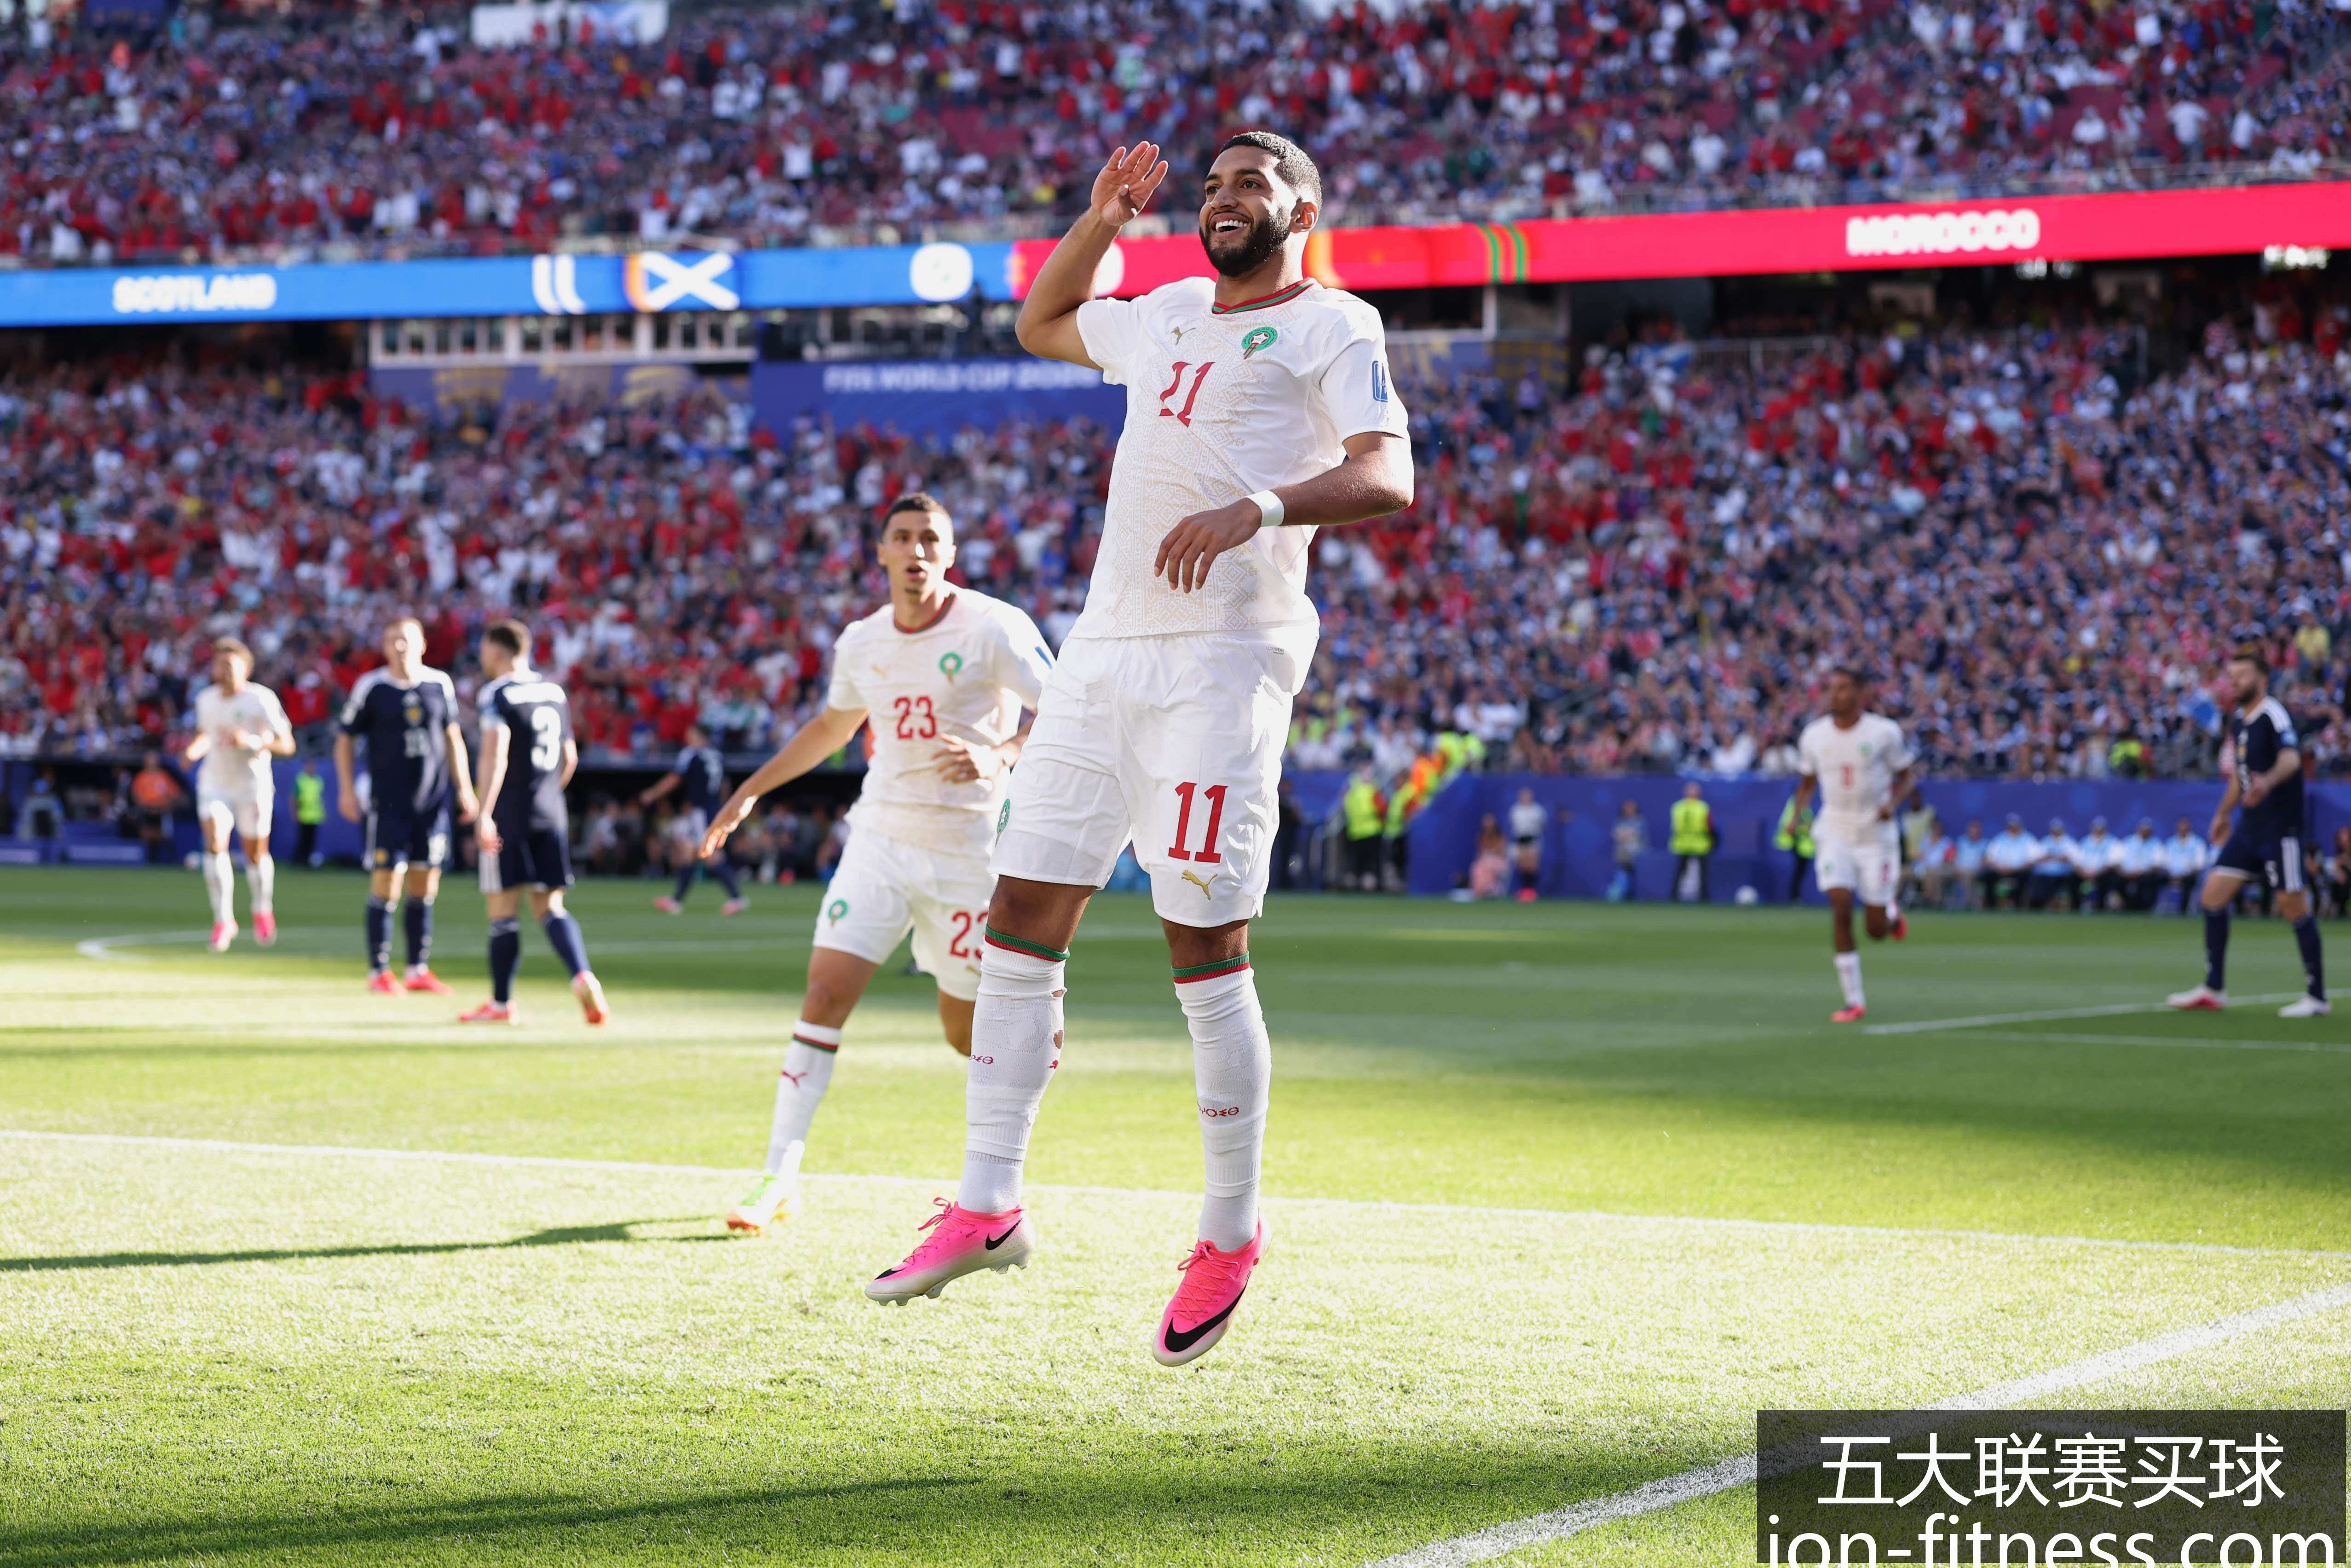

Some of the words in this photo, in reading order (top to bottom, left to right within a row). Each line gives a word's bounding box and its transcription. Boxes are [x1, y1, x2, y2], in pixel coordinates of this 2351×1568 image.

[1846, 208, 2040, 256] MOROCCO
[113, 273, 276, 313] SCOTLAND
[531, 705, 562, 771] 3
[893, 695, 938, 741] 23
[1168, 782, 1228, 864] 11
